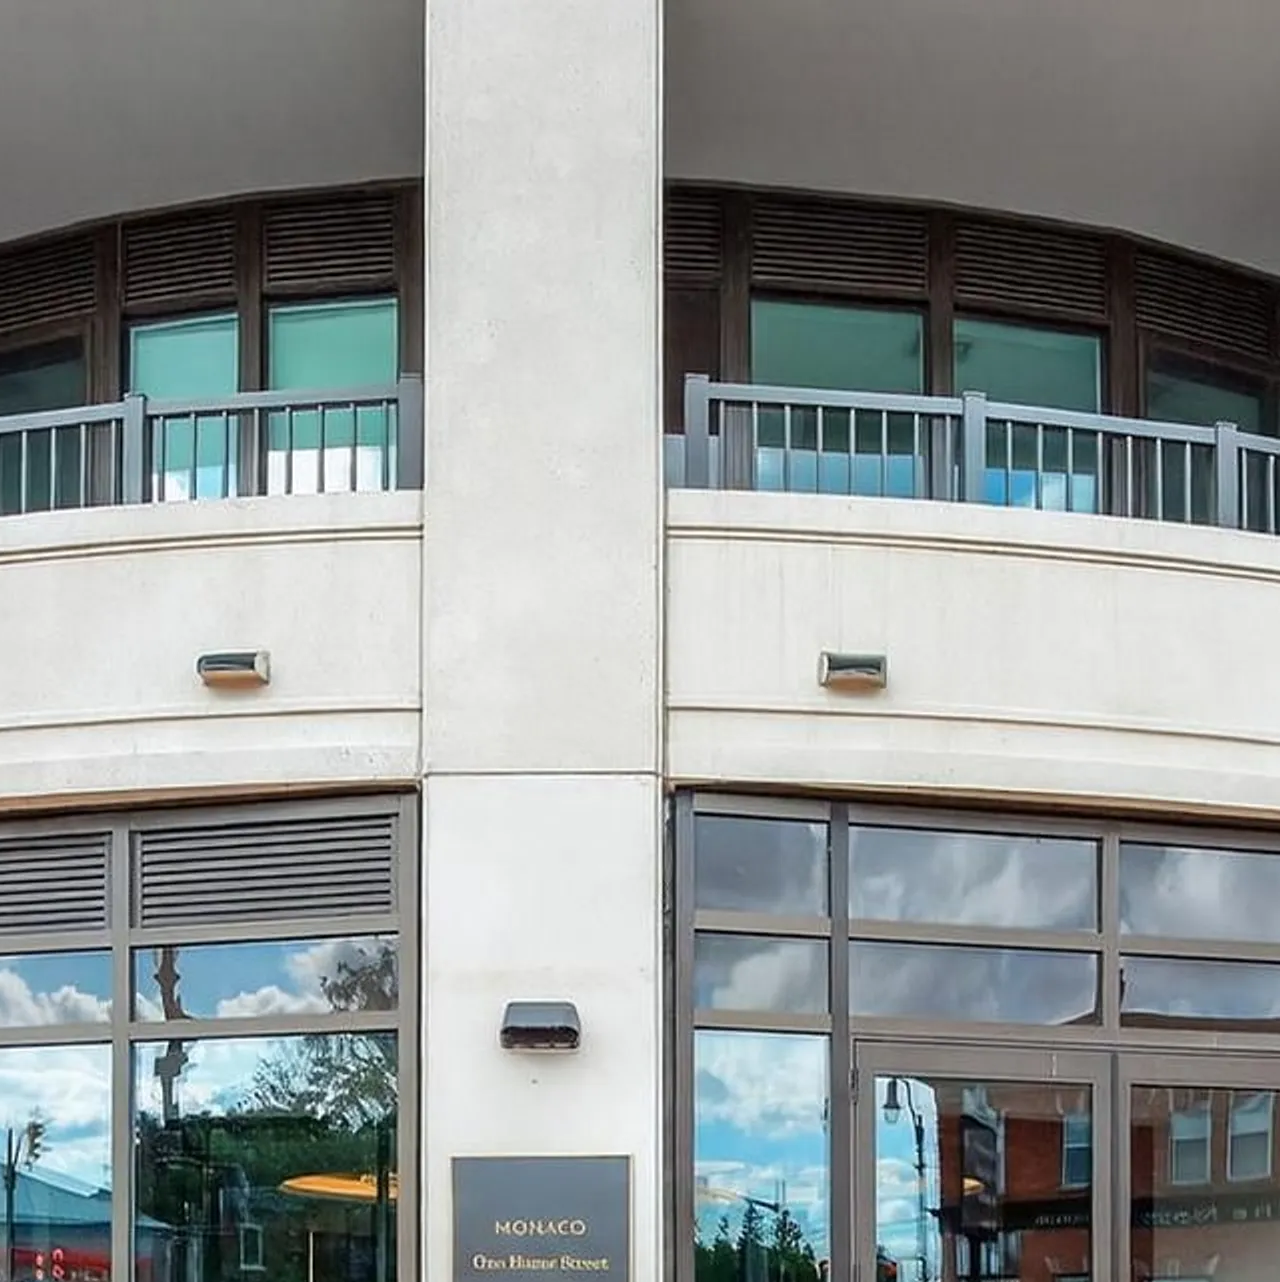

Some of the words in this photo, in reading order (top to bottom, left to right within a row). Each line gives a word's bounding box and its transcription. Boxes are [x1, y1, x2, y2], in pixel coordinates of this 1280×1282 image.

[494, 1219, 587, 1237] MONACO
[473, 1253, 507, 1270] One
[560, 1254, 610, 1271] Street
